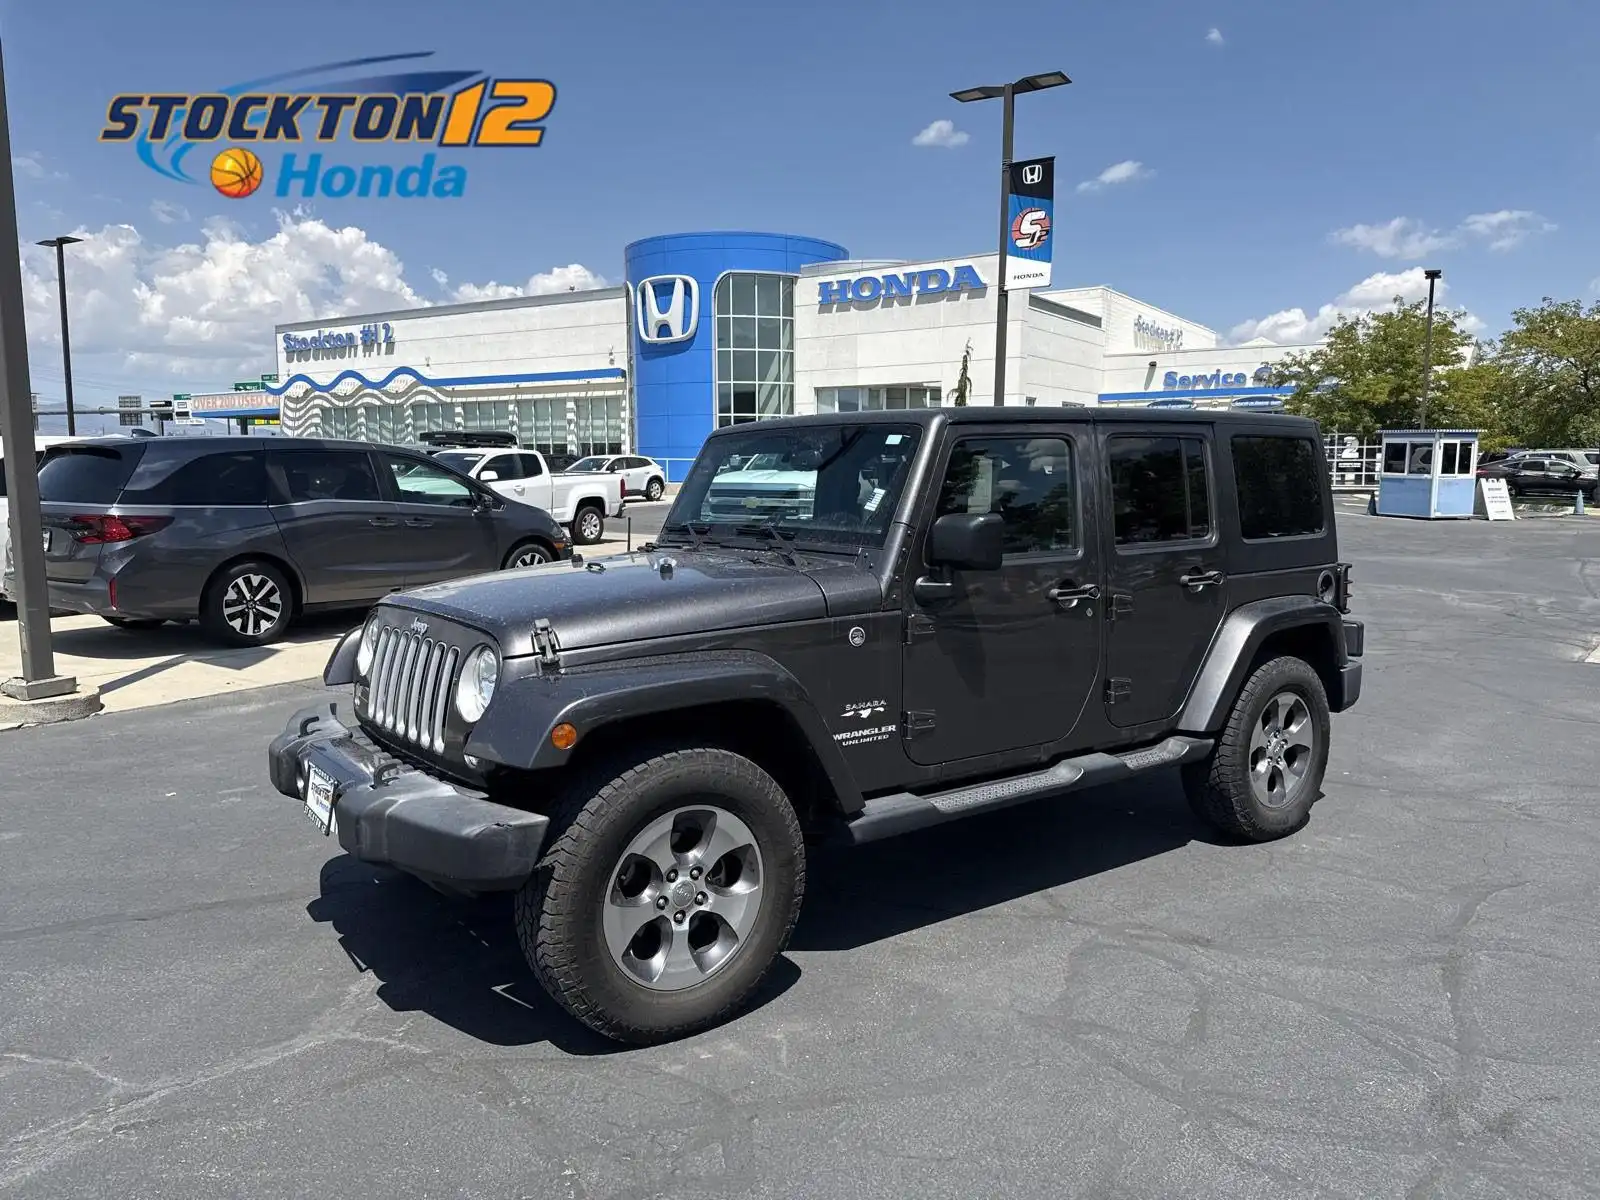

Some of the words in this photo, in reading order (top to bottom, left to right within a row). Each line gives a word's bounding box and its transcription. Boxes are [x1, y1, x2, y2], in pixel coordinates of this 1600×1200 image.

[1013, 272, 1044, 281] HONDA
[818, 265, 986, 305] HONDA
[283, 330, 355, 352] Stockton
[360, 322, 393, 346] #12
[1163, 369, 1247, 388] Service
[193, 397, 217, 409] OVER
[219, 396, 236, 408] 200
[239, 394, 261, 406] USED
[845, 700, 887, 711] SAHARA
[833, 724, 897, 741] WRANGLER
[842, 734, 890, 746] UNLIMITED
